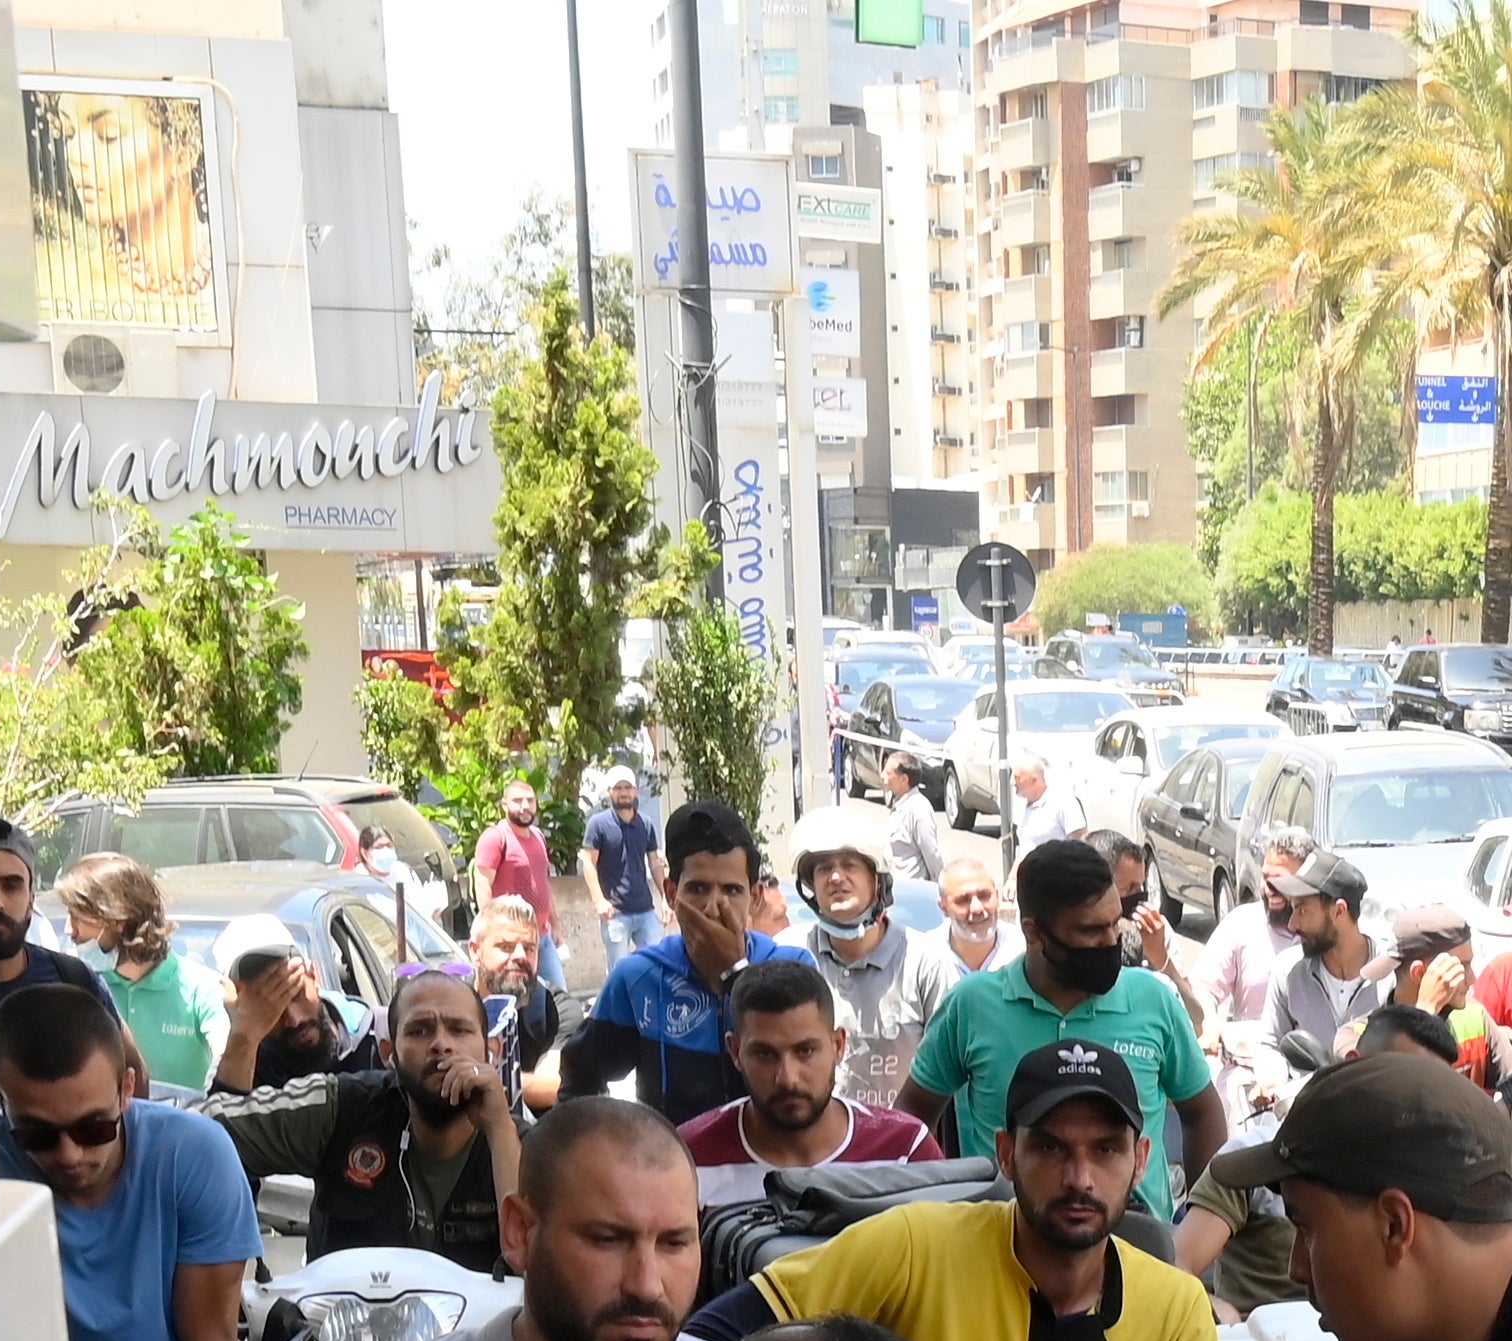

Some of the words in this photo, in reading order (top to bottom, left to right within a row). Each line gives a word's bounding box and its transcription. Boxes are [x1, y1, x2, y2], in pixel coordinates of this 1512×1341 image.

[0, 370, 481, 540] Machmouchi
[284, 505, 399, 527] PHARMACY
[161, 1022, 195, 1038] toters
[1112, 1039, 1155, 1061] toters
[1057, 1064, 1103, 1077] adidas
